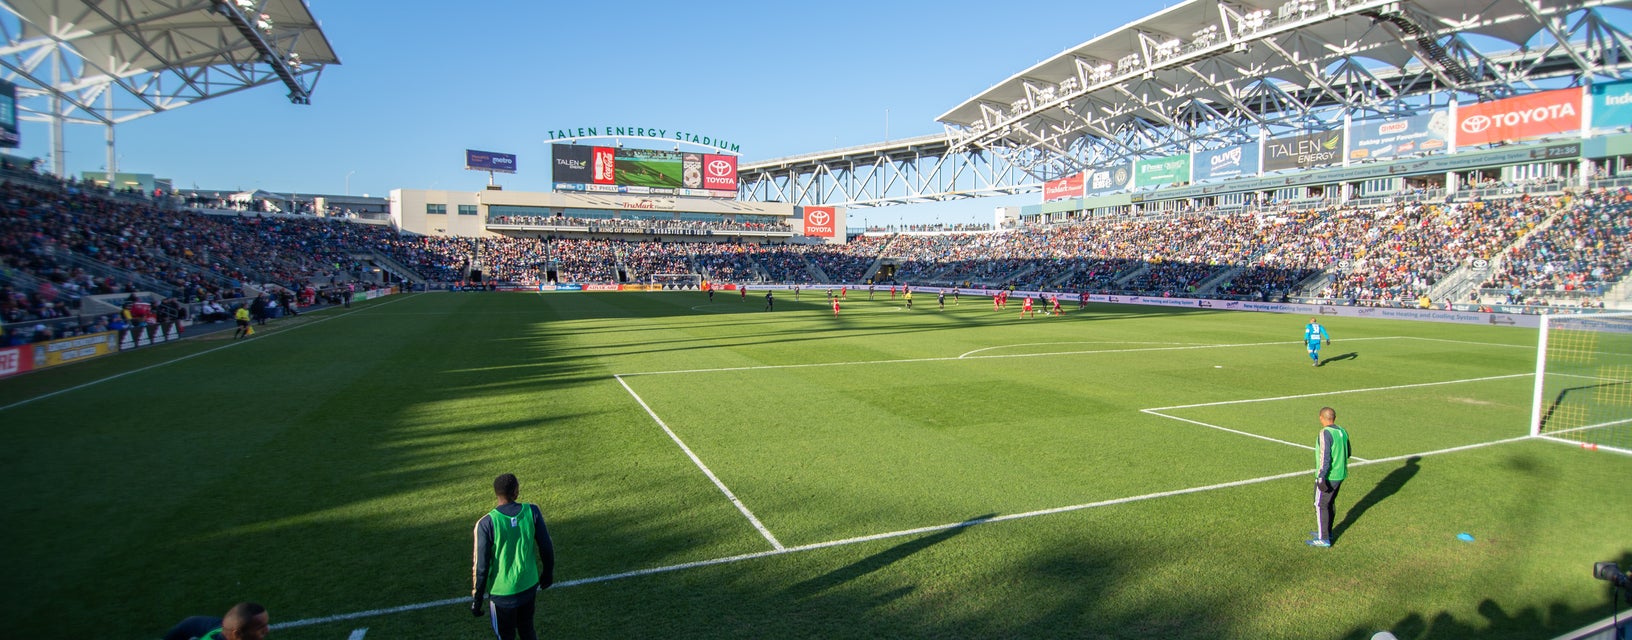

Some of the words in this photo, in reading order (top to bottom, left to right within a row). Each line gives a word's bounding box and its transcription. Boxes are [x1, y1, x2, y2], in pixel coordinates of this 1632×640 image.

[1491, 102, 1576, 128] TOYOTA
[1381, 122, 1406, 132] BIMBO
[548, 127, 597, 140] TALEN
[606, 126, 666, 139] ENERGY
[675, 131, 740, 153] STADIUM
[1210, 146, 1241, 166] OLIVER
[1268, 138, 1321, 158] TALEN
[1297, 151, 1336, 164] ENERGY
[1548, 146, 1577, 156] 72:36
[492, 156, 513, 164] metro
[556, 158, 580, 166] TALEN
[706, 176, 735, 184] TOYOTA
[622, 200, 654, 210] TruMark
[1396, 311, 1418, 319] Heating
